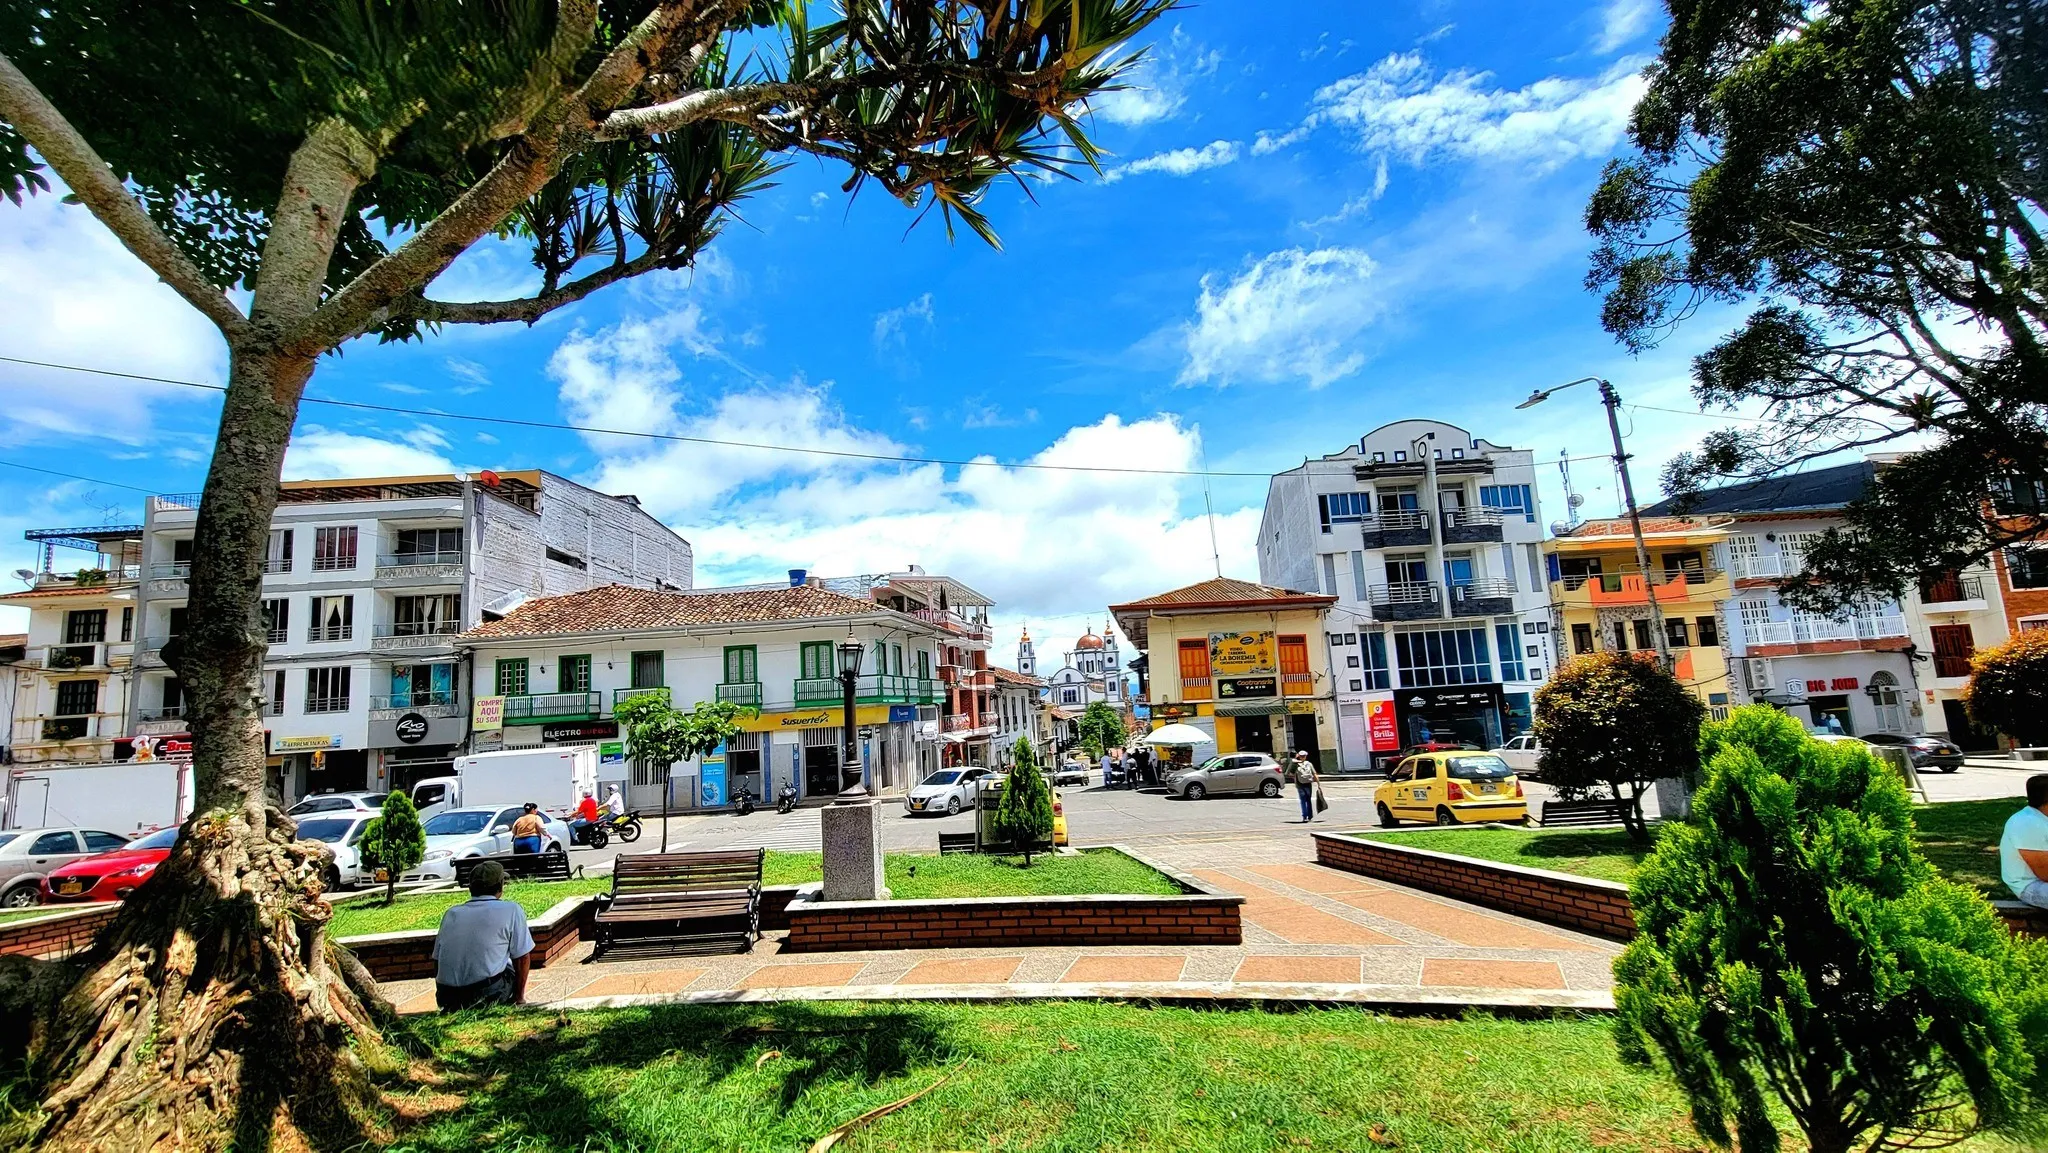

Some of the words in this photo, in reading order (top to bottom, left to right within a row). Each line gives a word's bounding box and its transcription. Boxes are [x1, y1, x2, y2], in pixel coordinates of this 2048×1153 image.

[1806, 680, 1827, 692] BIG
[1831, 678, 1859, 691] JOHN
[480, 707, 500, 716] AQUI
[486, 716, 500, 724] SOAT
[781, 715, 820, 726] Susuerte
[1373, 730, 1395, 738] Brilla
